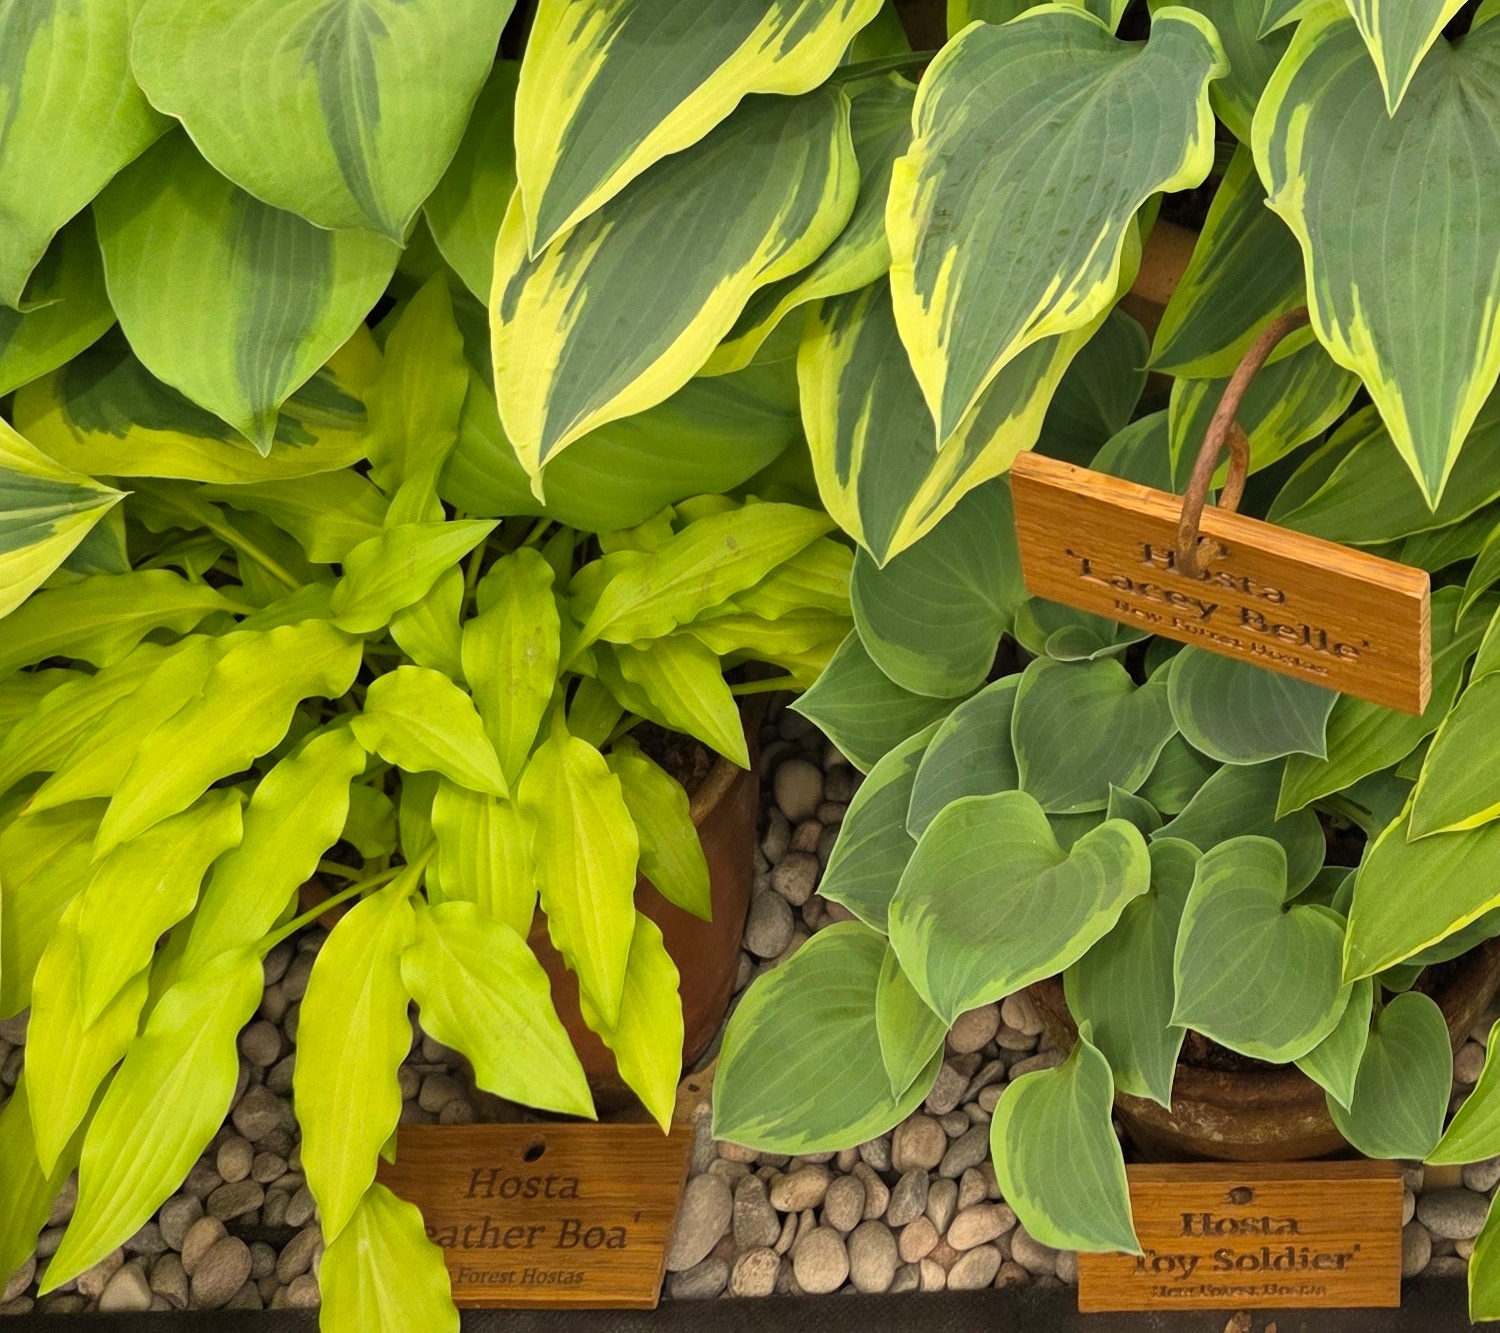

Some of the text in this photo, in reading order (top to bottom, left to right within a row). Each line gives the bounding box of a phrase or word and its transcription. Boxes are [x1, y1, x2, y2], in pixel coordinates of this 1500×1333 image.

[1064, 548, 1370, 663] 'Lacey Belle'
[463, 1167, 582, 1200] Hosta
[424, 1209, 644, 1250] eather Boa'
[1180, 1211, 1301, 1238] Hosta
[454, 1267, 586, 1286] Forest Hostas
